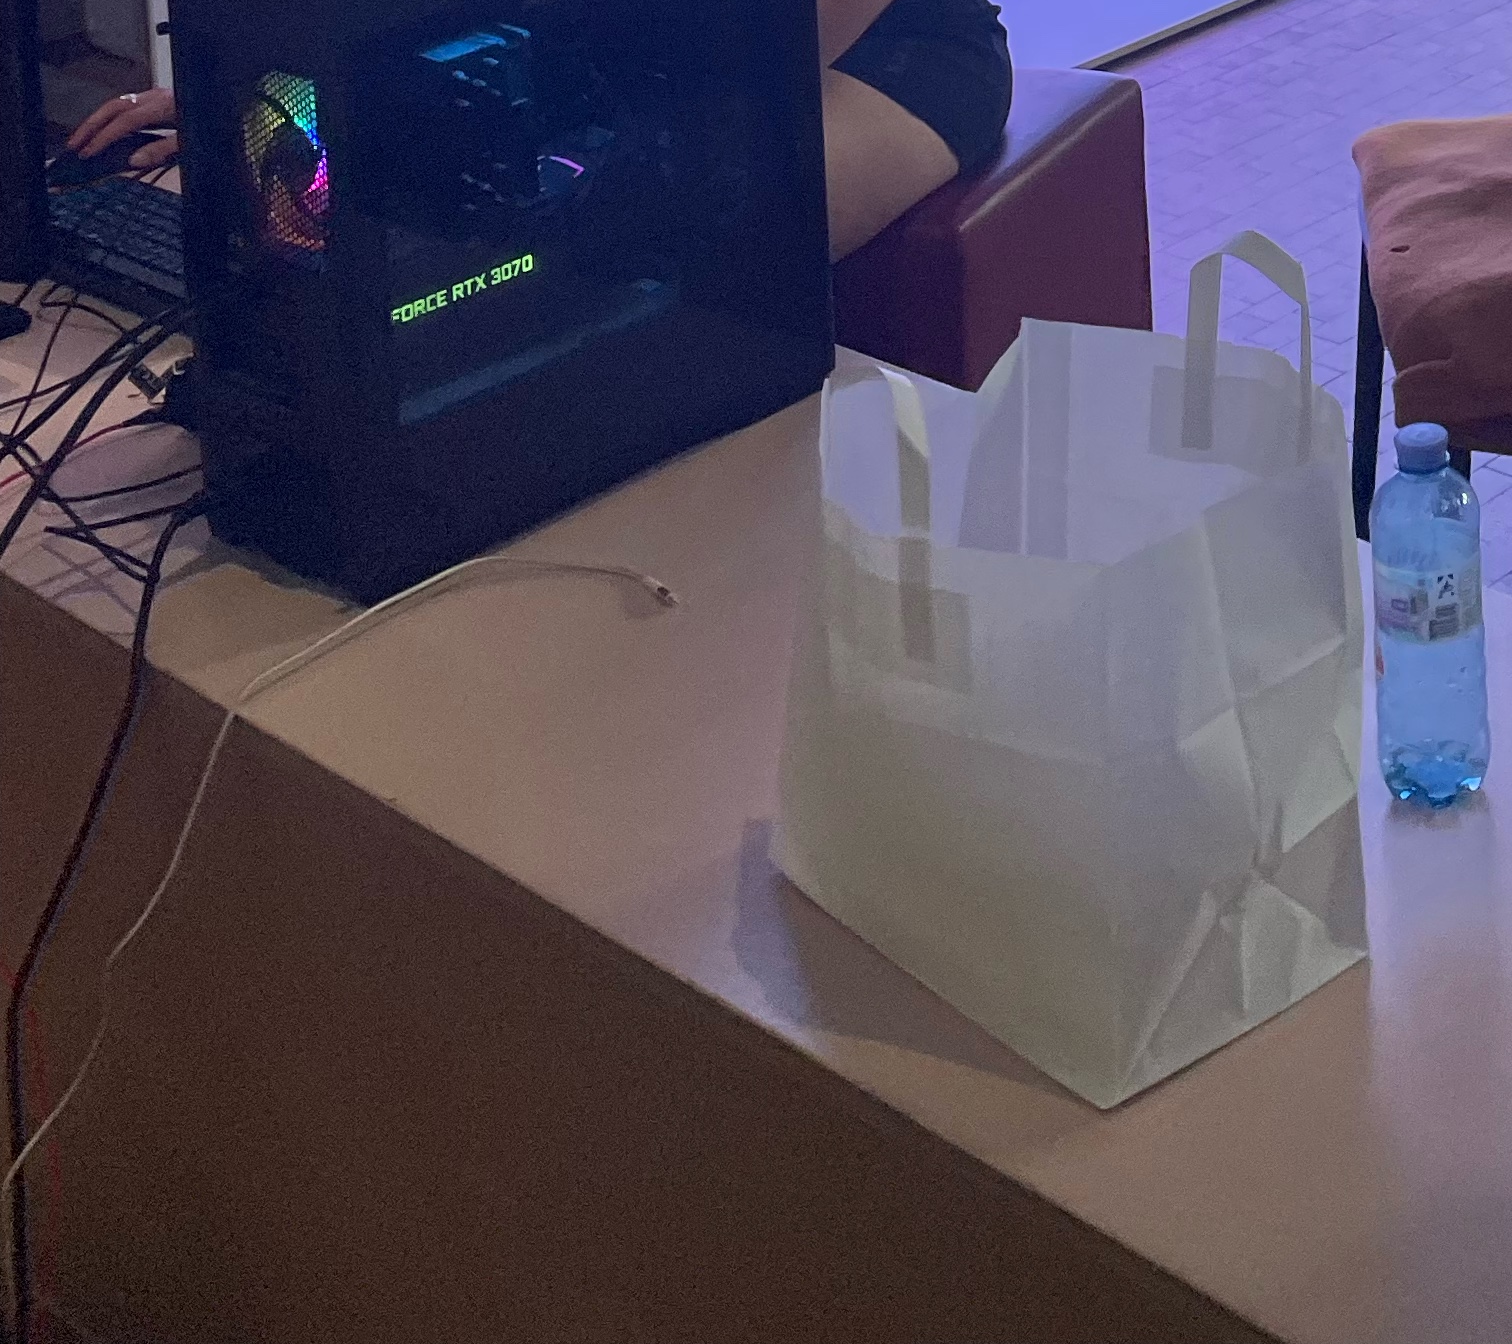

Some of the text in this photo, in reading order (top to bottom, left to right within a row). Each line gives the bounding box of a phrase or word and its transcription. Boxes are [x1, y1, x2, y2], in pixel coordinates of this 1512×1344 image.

[391, 253, 534, 323] FORCE RTX 3070
